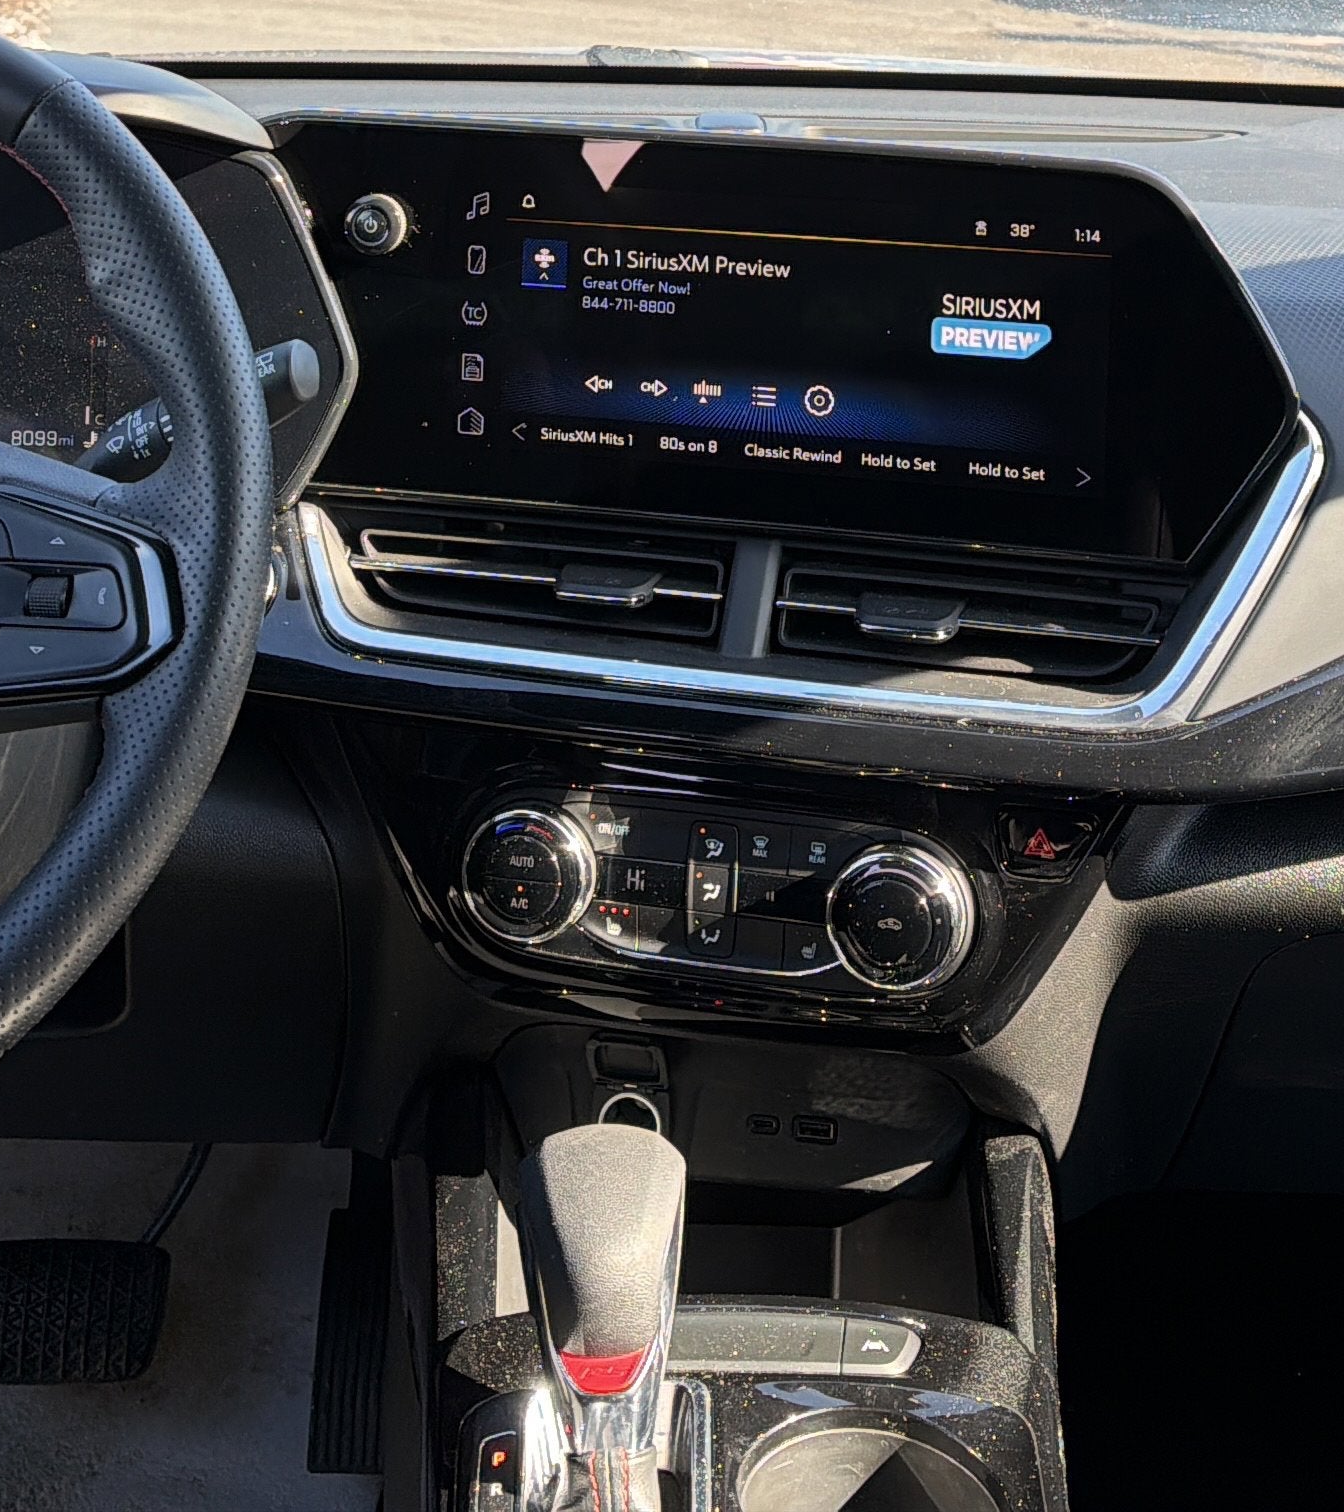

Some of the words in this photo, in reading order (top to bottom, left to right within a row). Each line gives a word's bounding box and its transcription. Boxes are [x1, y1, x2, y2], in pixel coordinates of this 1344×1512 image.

[1010, 223, 1036, 238] 38°
[1074, 229, 1101, 244] 1:14
[583, 248, 610, 267] Ch
[615, 249, 621, 268] 1
[628, 249, 709, 273] SiriusXM
[716, 256, 791, 279] Preview
[582, 276, 618, 292] Great
[620, 278, 655, 293] Offer
[658, 280, 691, 296] Now!
[467, 305, 482, 321] TC
[581, 295, 676, 315] 844-711-8800
[942, 293, 1041, 322] SIRIUSXM
[940, 324, 1041, 352] PREVIEW
[257, 364, 276, 377] EAR
[599, 378, 613, 391] CH
[640, 381, 655, 393] CH
[11, 430, 58, 447] 8099
[59, 434, 74, 447] mi
[540, 427, 596, 444] SiriusXM
[599, 432, 625, 447] Hits
[627, 433, 634, 447] 1
[659, 436, 685, 452] 80s
[688, 441, 705, 453] on
[744, 443, 790, 461] Classic
[793, 447, 842, 464] Rewind
[861, 452, 893, 469] Hold
[896, 457, 911, 470] to
[913, 457, 937, 472] Set
[968, 461, 1001, 478] Hold
[1004, 465, 1019, 479] to
[1022, 466, 1046, 481] Set
[597, 822, 630, 836] ON/OFF
[509, 855, 535, 868] AUTO
[752, 848, 769, 859] MAX
[808, 855, 826, 865] REAR
[626, 868, 646, 891] Hi
[510, 897, 529, 910] A/C
[492, 1450, 506, 1467] P
[490, 1483, 504, 1496] R
